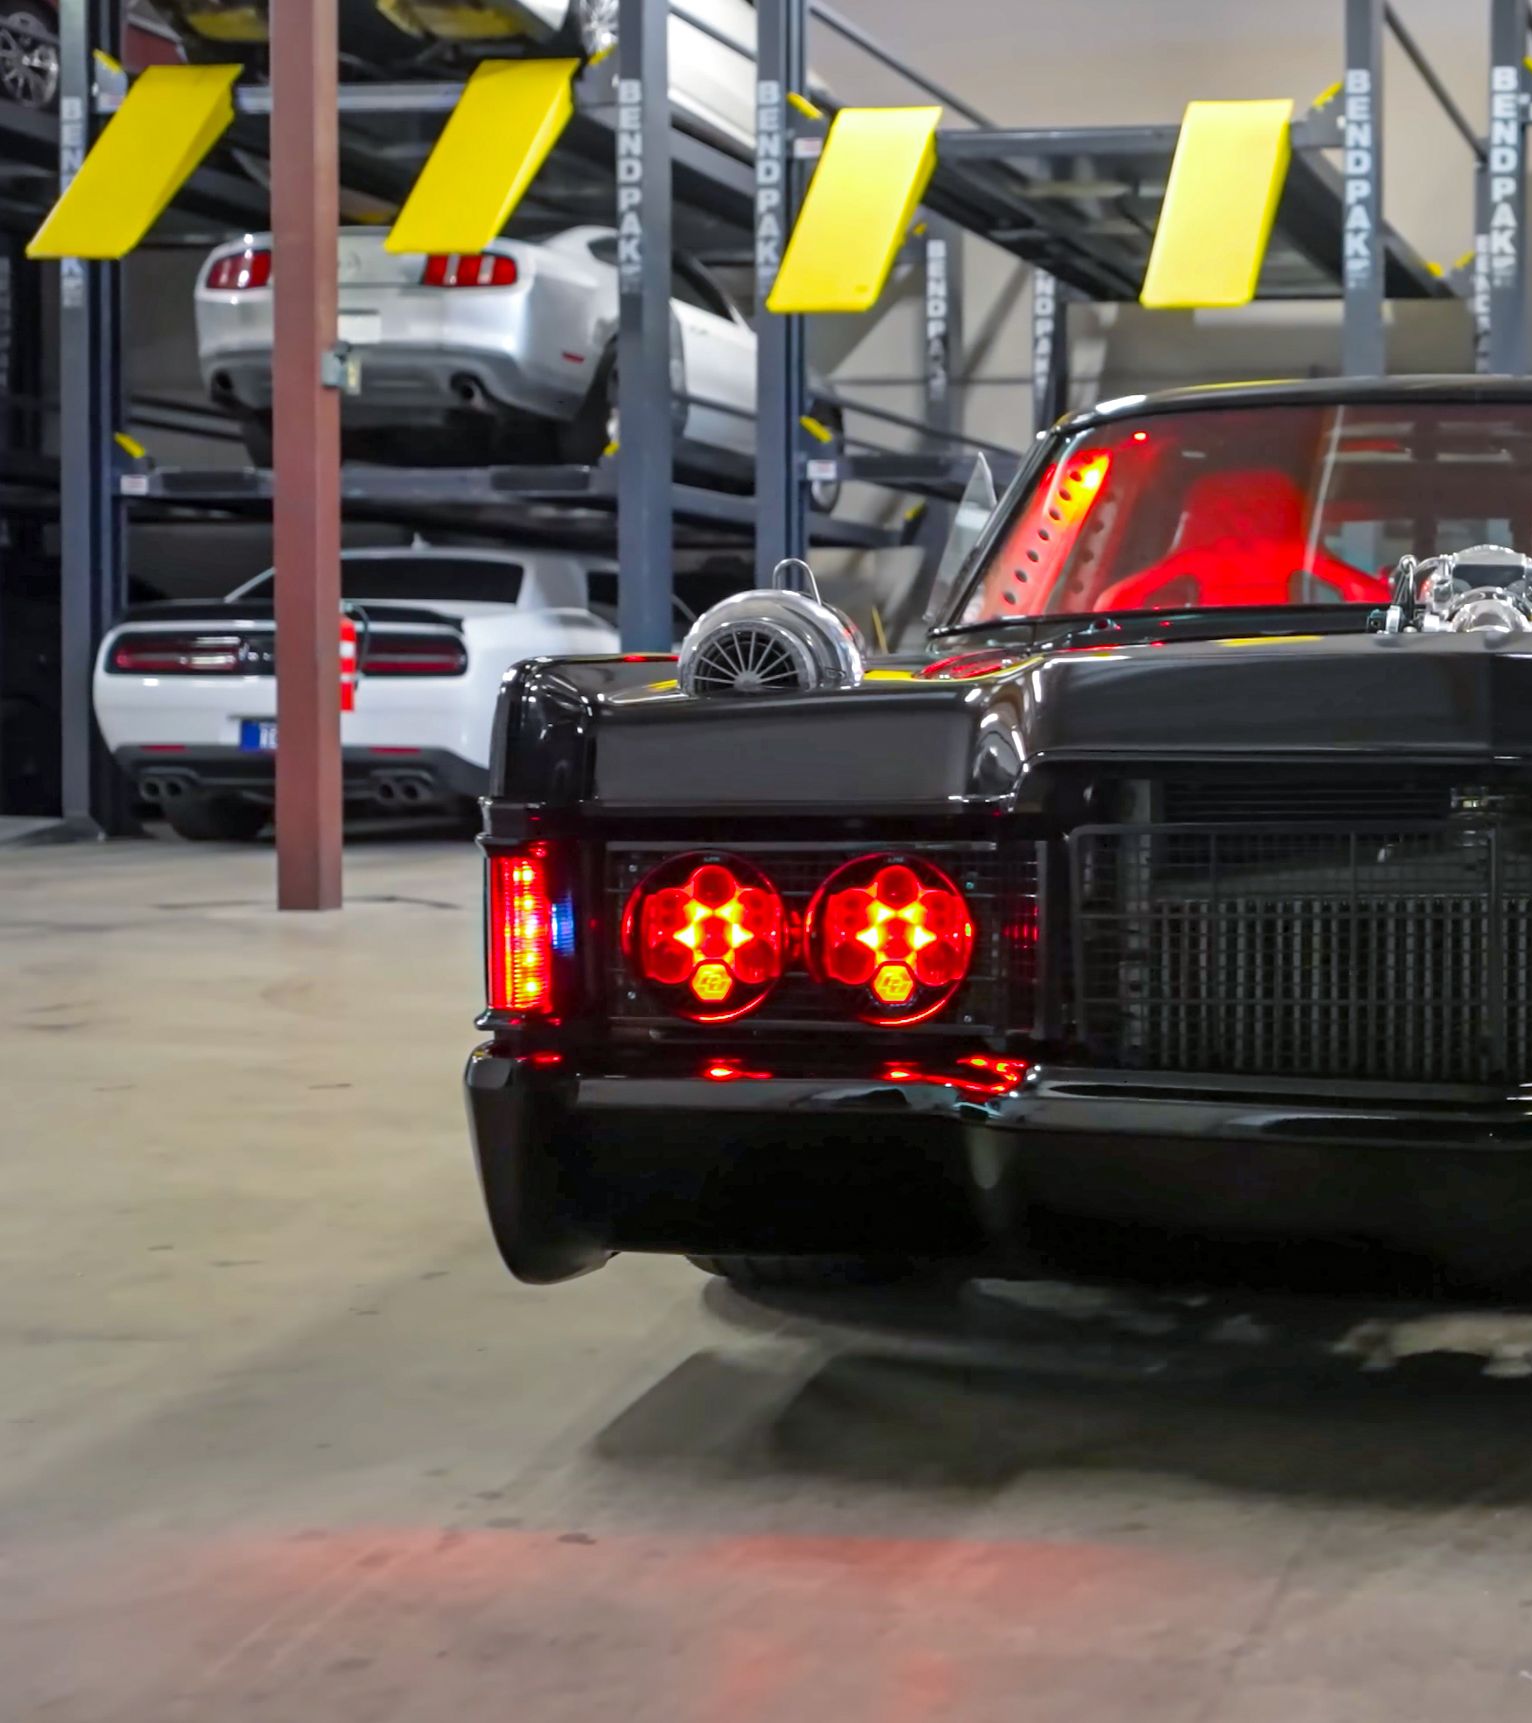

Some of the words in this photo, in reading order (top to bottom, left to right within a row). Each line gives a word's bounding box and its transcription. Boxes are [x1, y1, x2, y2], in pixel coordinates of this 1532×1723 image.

[619, 80, 642, 262] BENDPAK
[757, 81, 780, 263] BENDPAK
[1345, 69, 1371, 258] BENDPAK
[1491, 67, 1517, 254] BENDPAK
